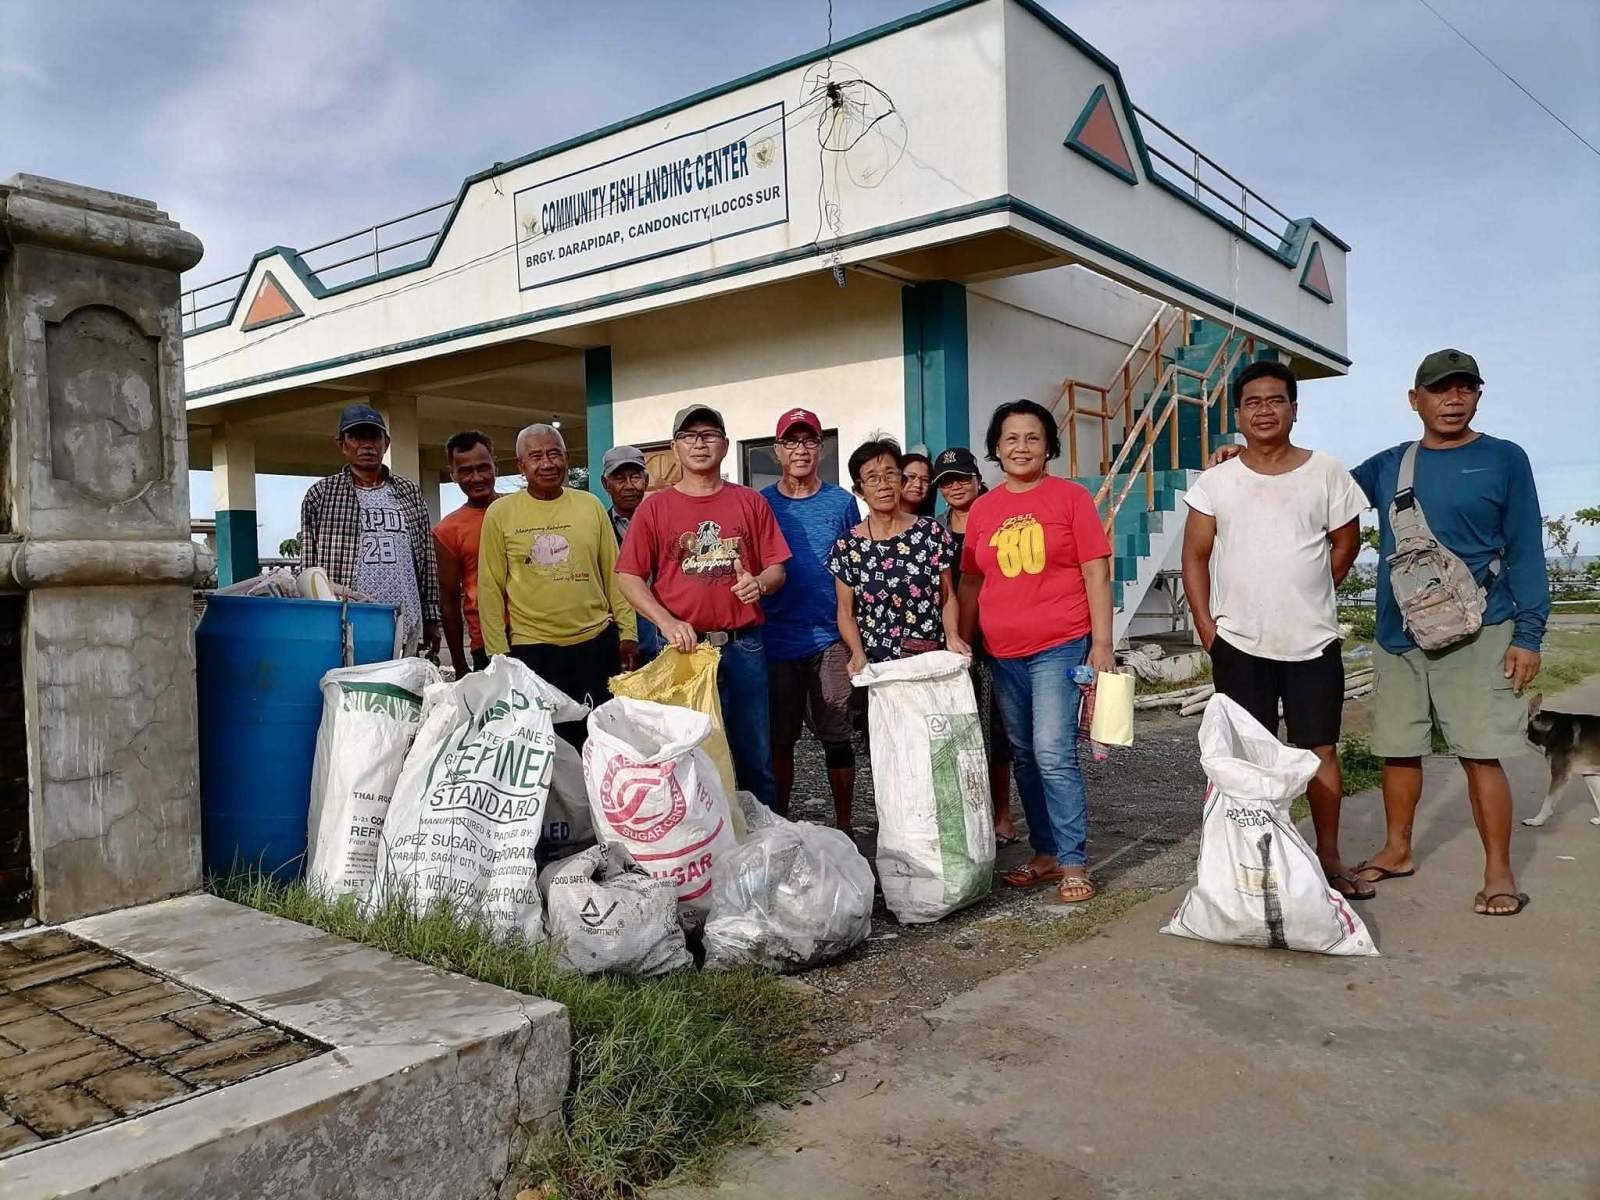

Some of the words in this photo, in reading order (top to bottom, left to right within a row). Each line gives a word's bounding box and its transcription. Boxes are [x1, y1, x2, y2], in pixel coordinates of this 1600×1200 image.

[541, 185, 607, 235] COMMUNITY
[609, 175, 635, 216] FISH
[637, 158, 692, 207] LANDING
[695, 140, 749, 191] CENTER
[525, 250, 556, 268] BRGY.
[558, 231, 624, 258] DARAPIDAP,
[755, 185, 780, 204] SUR
[362, 536, 397, 565] 28
[353, 791, 375, 801] THAI
[430, 786, 539, 818] STANDARD
[1238, 816, 1272, 828] SUGA
[622, 825, 666, 841] SUGAR
[431, 834, 477, 851] SUGAR
[430, 852, 456, 864] SAGAY
[498, 866, 537, 877] OCCIDENTA
[343, 879, 365, 887] NET
[580, 925, 621, 936] sugarmark
